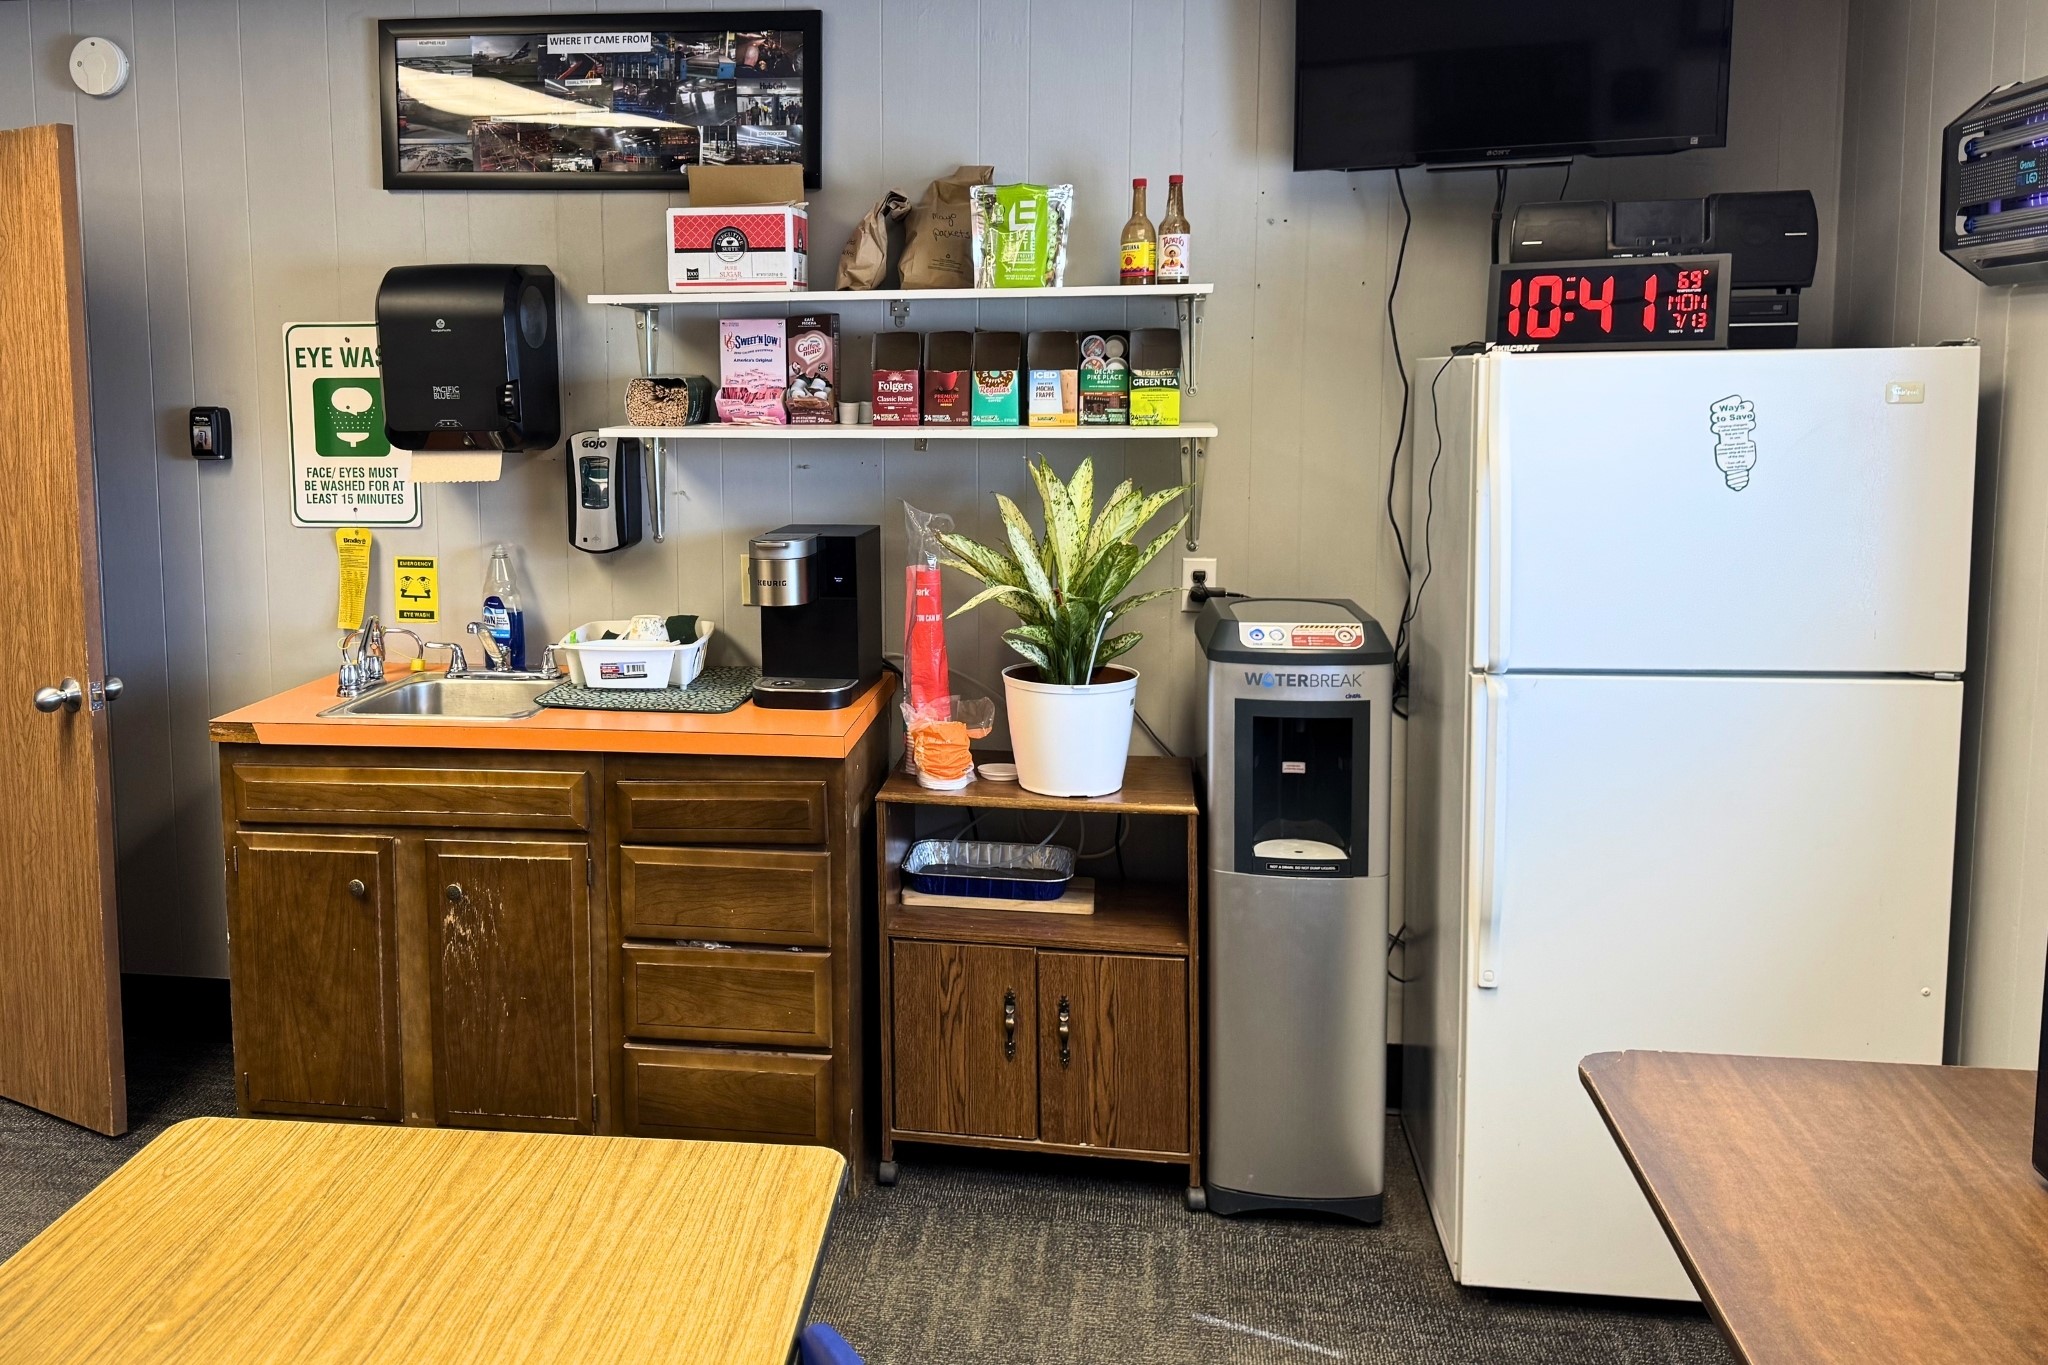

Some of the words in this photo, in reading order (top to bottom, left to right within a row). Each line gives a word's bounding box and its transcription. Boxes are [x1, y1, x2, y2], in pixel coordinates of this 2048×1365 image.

[550, 37, 581, 45] WHERE
[584, 36, 591, 44] IT
[594, 35, 620, 44] CAME
[622, 35, 649, 43] FROM
[932, 213, 956, 227] Mayo
[717, 232, 744, 246] EXECUTIVE
[798, 343, 820, 352] Coffee
[804, 348, 821, 356] mate
[295, 347, 333, 368] EYE
[878, 381, 913, 392] Folgers
[979, 385, 1010, 396] Regular
[307, 467, 336, 479] FACE/
[340, 467, 365, 478] EYES
[369, 467, 398, 478] MUST
[304, 481, 319, 491] BE
[321, 481, 365, 491] WASHED
[369, 481, 390, 491] FOR
[393, 481, 405, 491] AT
[307, 494, 339, 504] LEAST
[342, 494, 354, 504] 15
[358, 494, 404, 504] MINUTES
